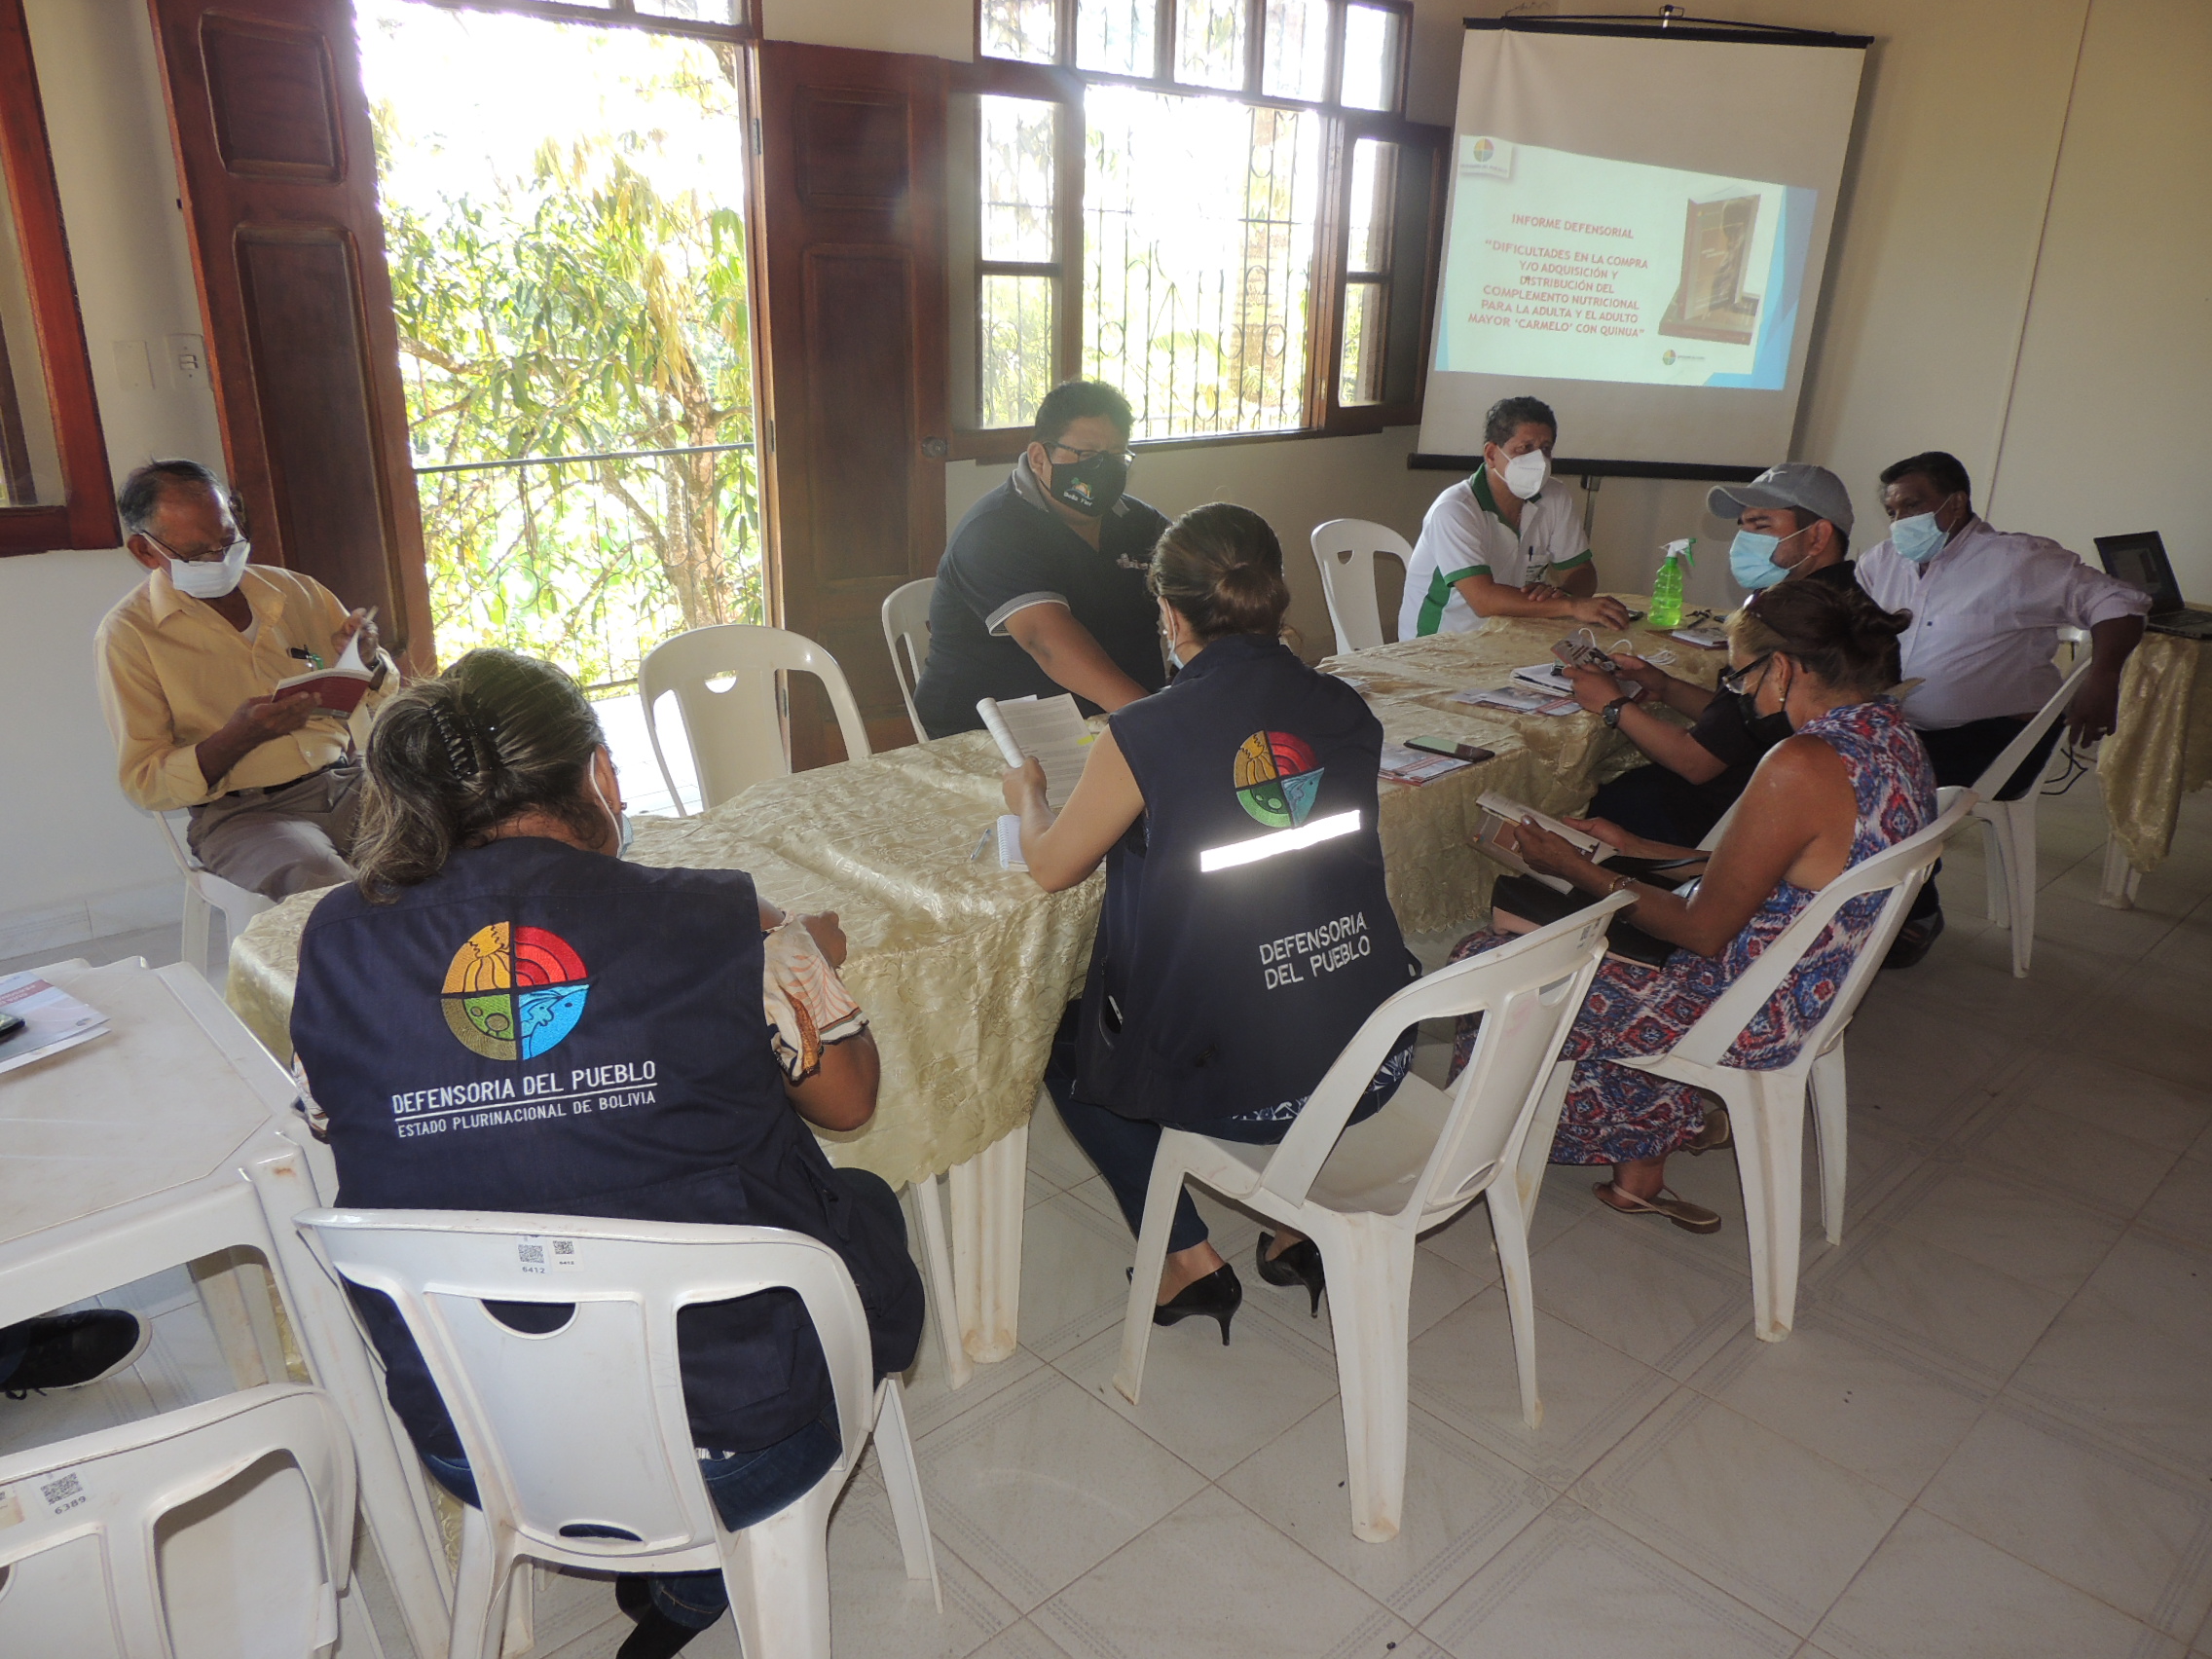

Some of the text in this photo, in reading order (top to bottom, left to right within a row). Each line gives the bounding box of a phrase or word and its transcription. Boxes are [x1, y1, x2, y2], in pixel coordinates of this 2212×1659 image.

[1512, 214, 1634, 239] INFORME DEFENSORIAL
[1519, 260, 1618, 279] Y/O ADQUISICIÓN Y
[1573, 252, 1589, 262] EN
[1591, 254, 1604, 264] LA
[1606, 256, 1648, 269] COMPRA
[1520, 276, 1614, 294] DISTRIBUCIÓN DEL
[1483, 285, 1640, 310] COMPLEMENTO NUTRICIONAL
[1481, 299, 1639, 323] PARA LA ADULTA Y EL ADULTO
[1468, 313, 1511, 326] MAYOR
[1575, 323, 1598, 334] CON
[1259, 911, 1369, 966] DEFENSORIA
[1264, 935, 1371, 991] DEL PUEBLO
[391, 1059, 657, 1114] DEFENSORIA DEL PUEBLO
[397, 1089, 656, 1138] ESTADO PLURINACIONAL DE BOLIVIA
[55, 1495, 87, 1514] 6389
